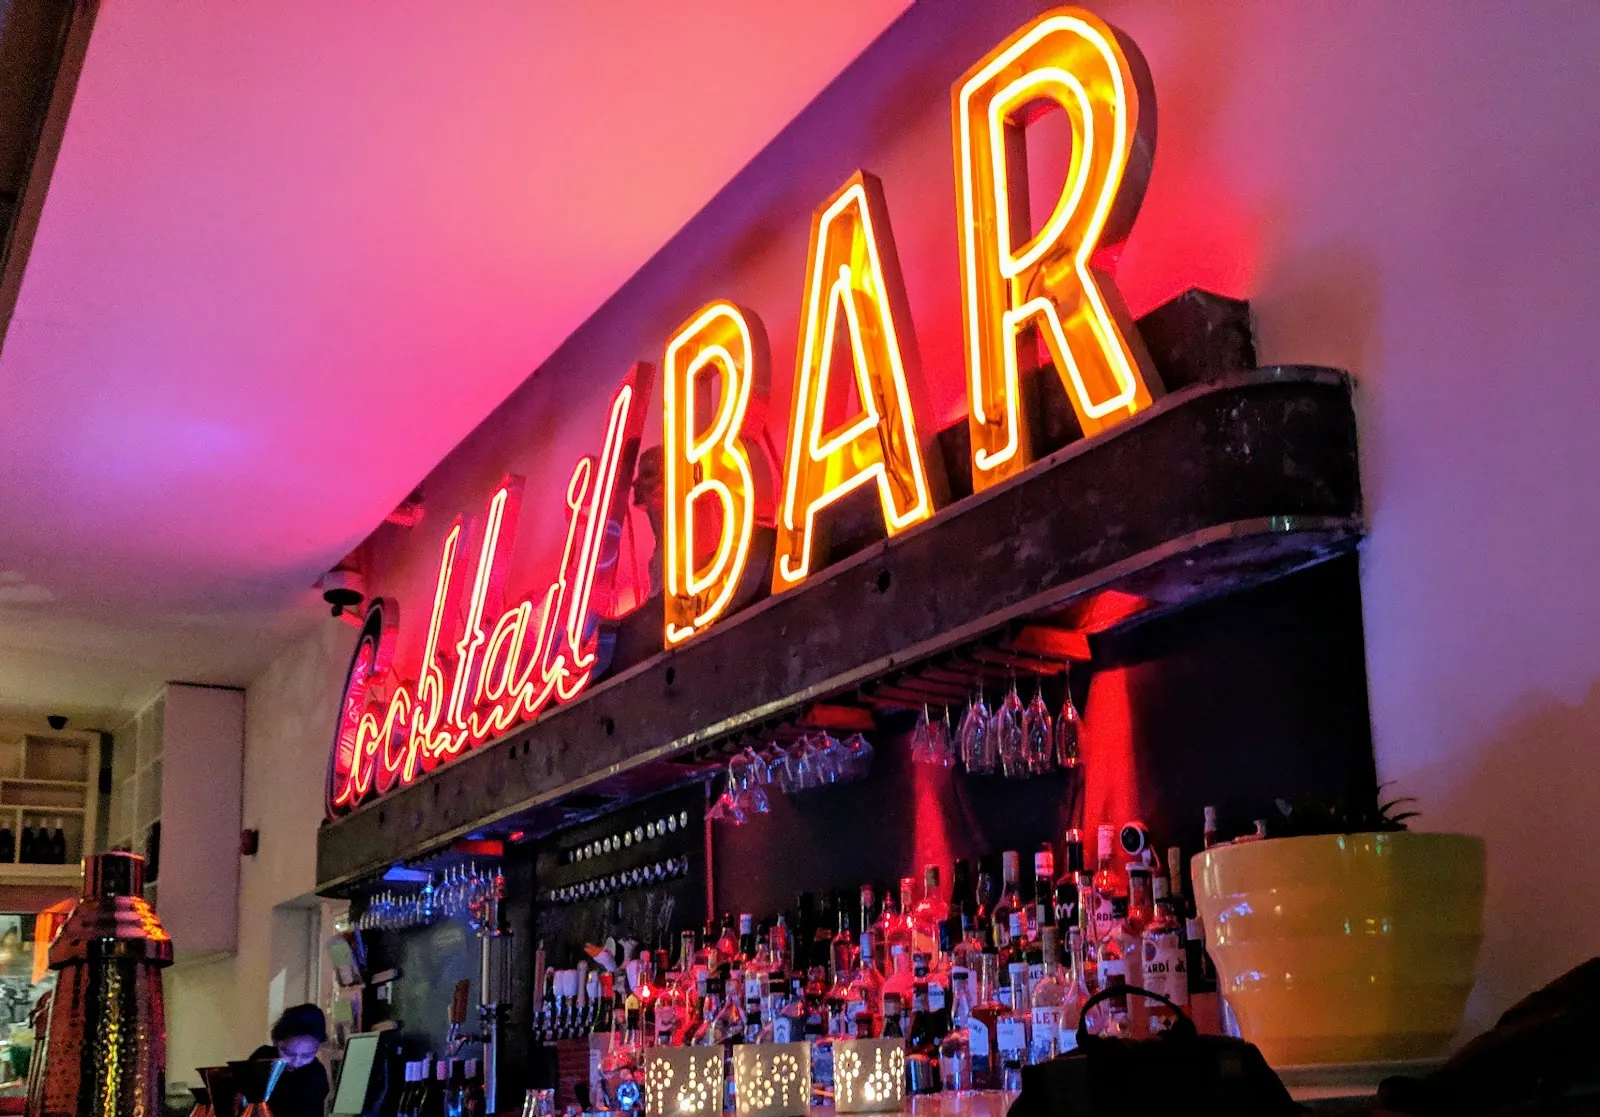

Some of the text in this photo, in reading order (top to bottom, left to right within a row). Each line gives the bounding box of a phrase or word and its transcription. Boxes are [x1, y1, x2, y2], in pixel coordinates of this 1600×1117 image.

[326, 5, 1155, 821] Cocktail BAR
[1031, 1011, 1060, 1025] LET
